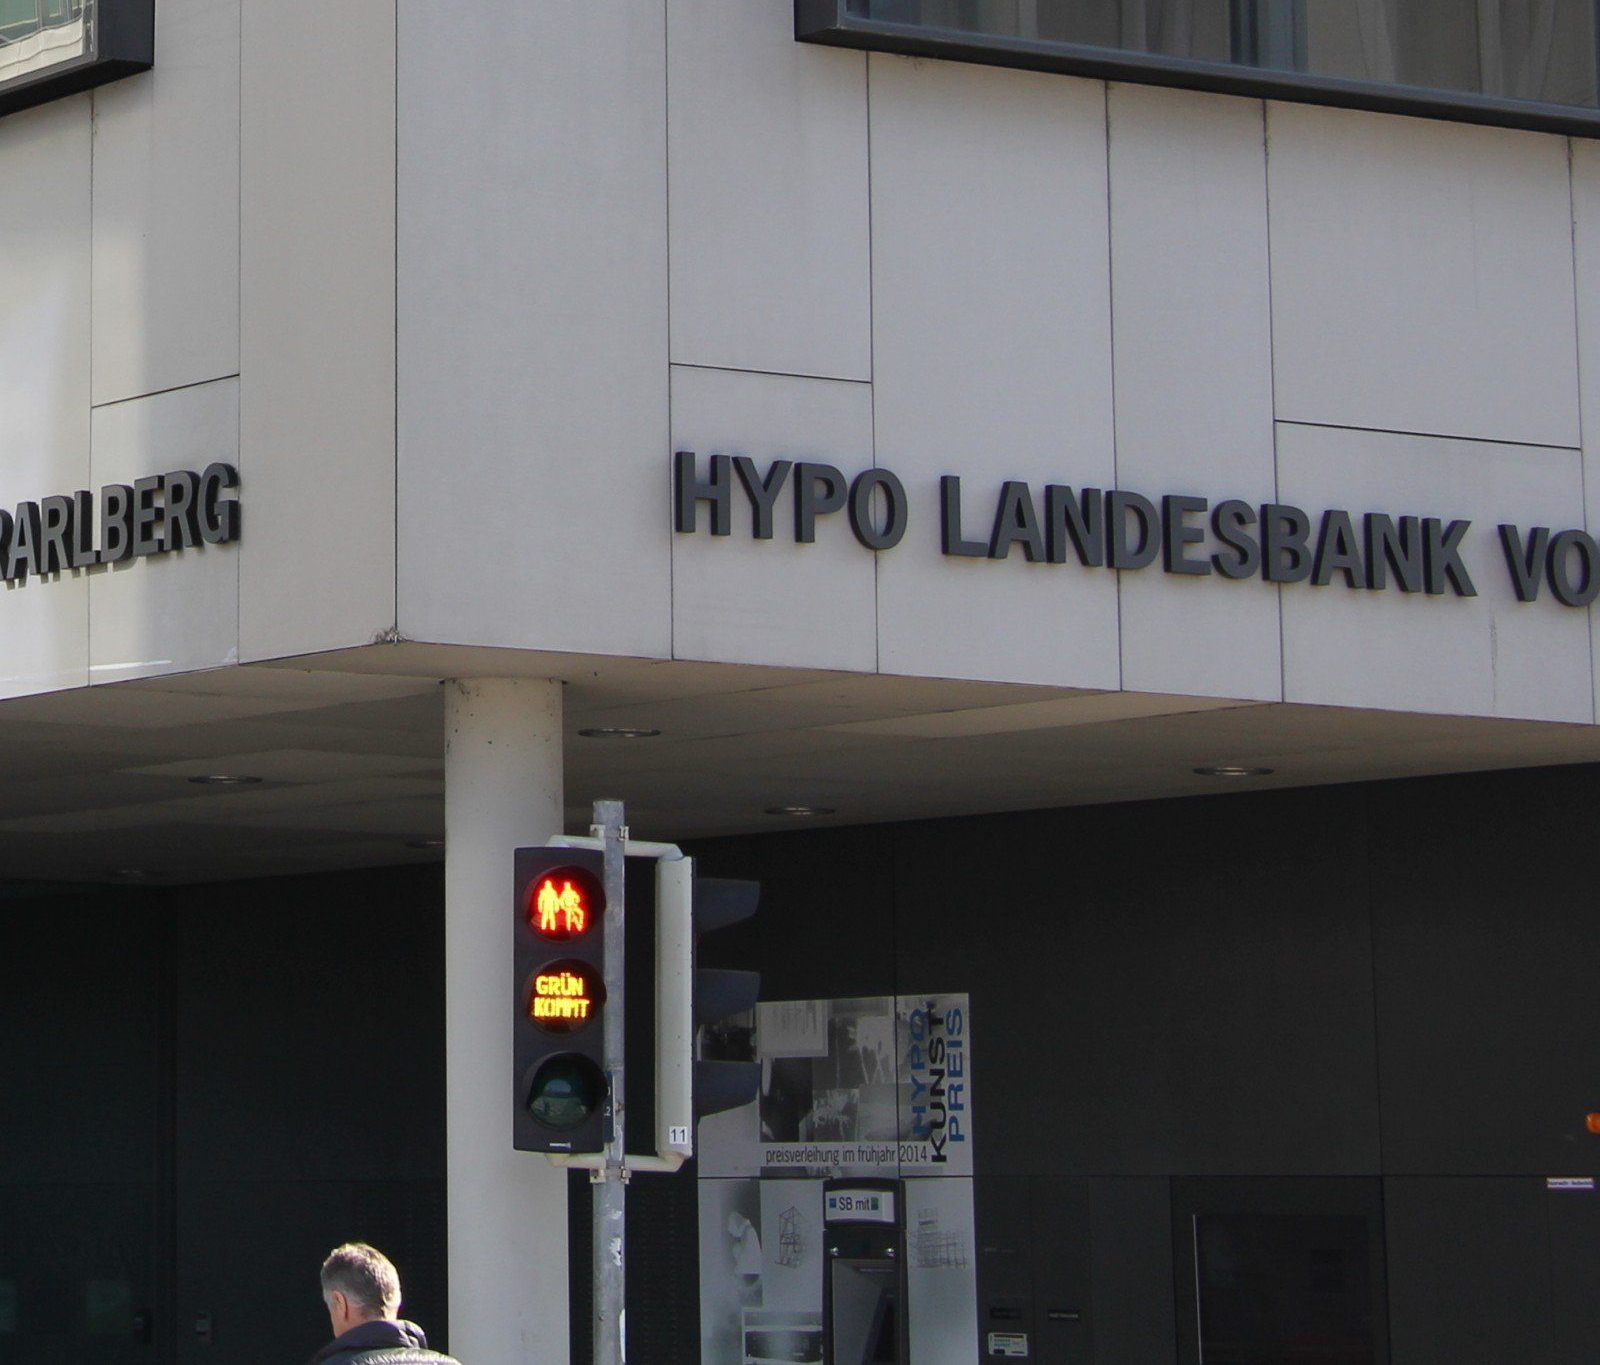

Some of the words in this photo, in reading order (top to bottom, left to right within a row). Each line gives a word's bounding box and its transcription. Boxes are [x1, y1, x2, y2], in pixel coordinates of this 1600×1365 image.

[675, 451, 908, 551] HYPO
[940, 475, 1478, 597] LANDESBANK
[1497, 524, 1600, 607] VO
[535, 972, 584, 996] GRÜN
[534, 997, 590, 1018] KOMMT
[928, 1002, 947, 1163] KUNST
[946, 1008, 965, 1142] PREIS
[670, 1128, 686, 1143] 11
[766, 1146, 839, 1166] preisverleihung
[842, 1146, 855, 1163] im
[858, 1145, 896, 1166] frühjahr
[900, 1145, 927, 1163] 2014
[839, 1196, 852, 1211] SB
[856, 1196, 870, 1211] mit
